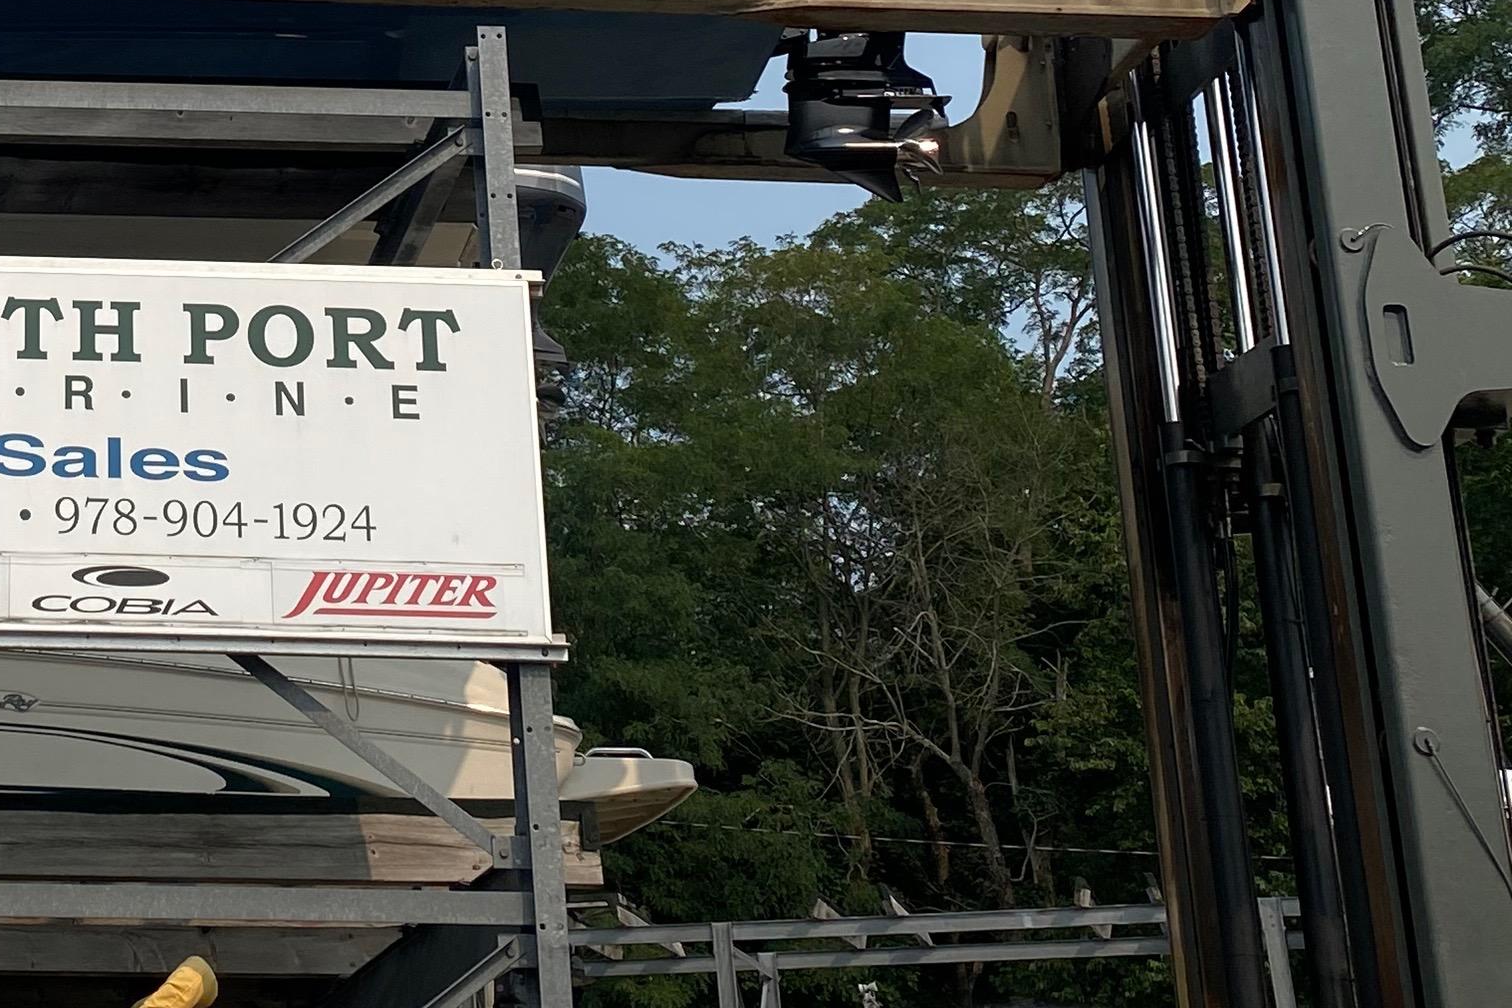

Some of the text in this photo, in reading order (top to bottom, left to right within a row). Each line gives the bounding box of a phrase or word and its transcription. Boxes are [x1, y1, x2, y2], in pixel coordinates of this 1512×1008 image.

[182, 302, 461, 372] PORT
[54, 496, 377, 543] 978-904-1924
[31, 595, 220, 617] COBIA
[281, 570, 498, 619] JUPITER
